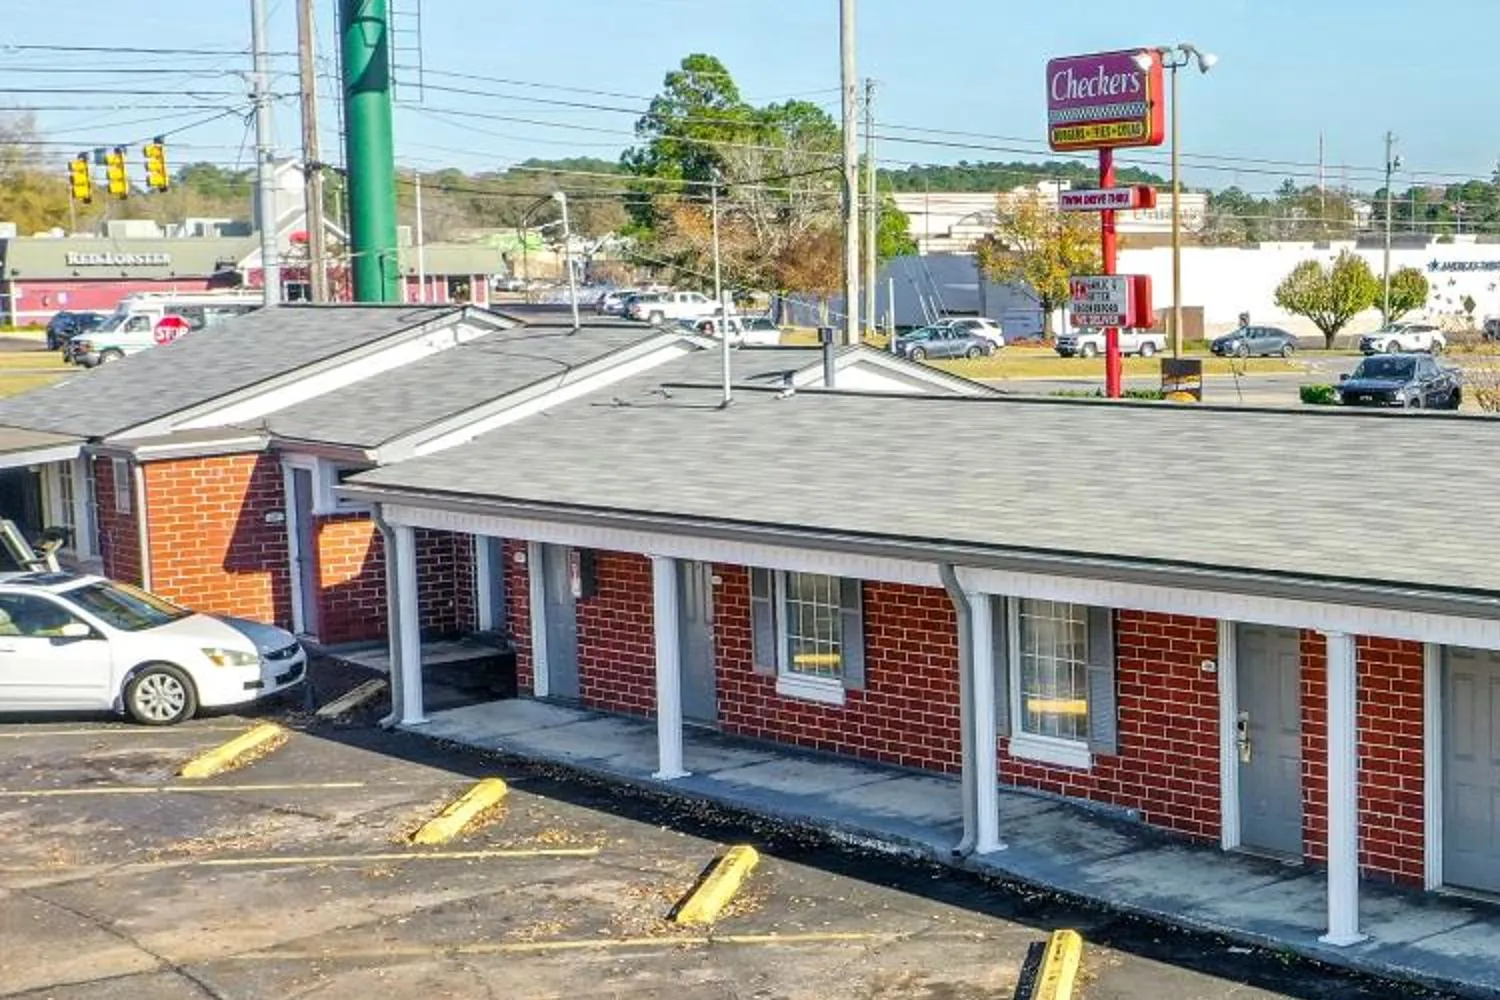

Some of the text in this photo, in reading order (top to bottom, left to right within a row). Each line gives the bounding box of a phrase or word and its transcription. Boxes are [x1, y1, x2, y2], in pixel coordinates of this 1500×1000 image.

[1051, 66, 1140, 101] Checkers
[1083, 193, 1106, 205] DRIVE
[155, 326, 190, 342] STOP
